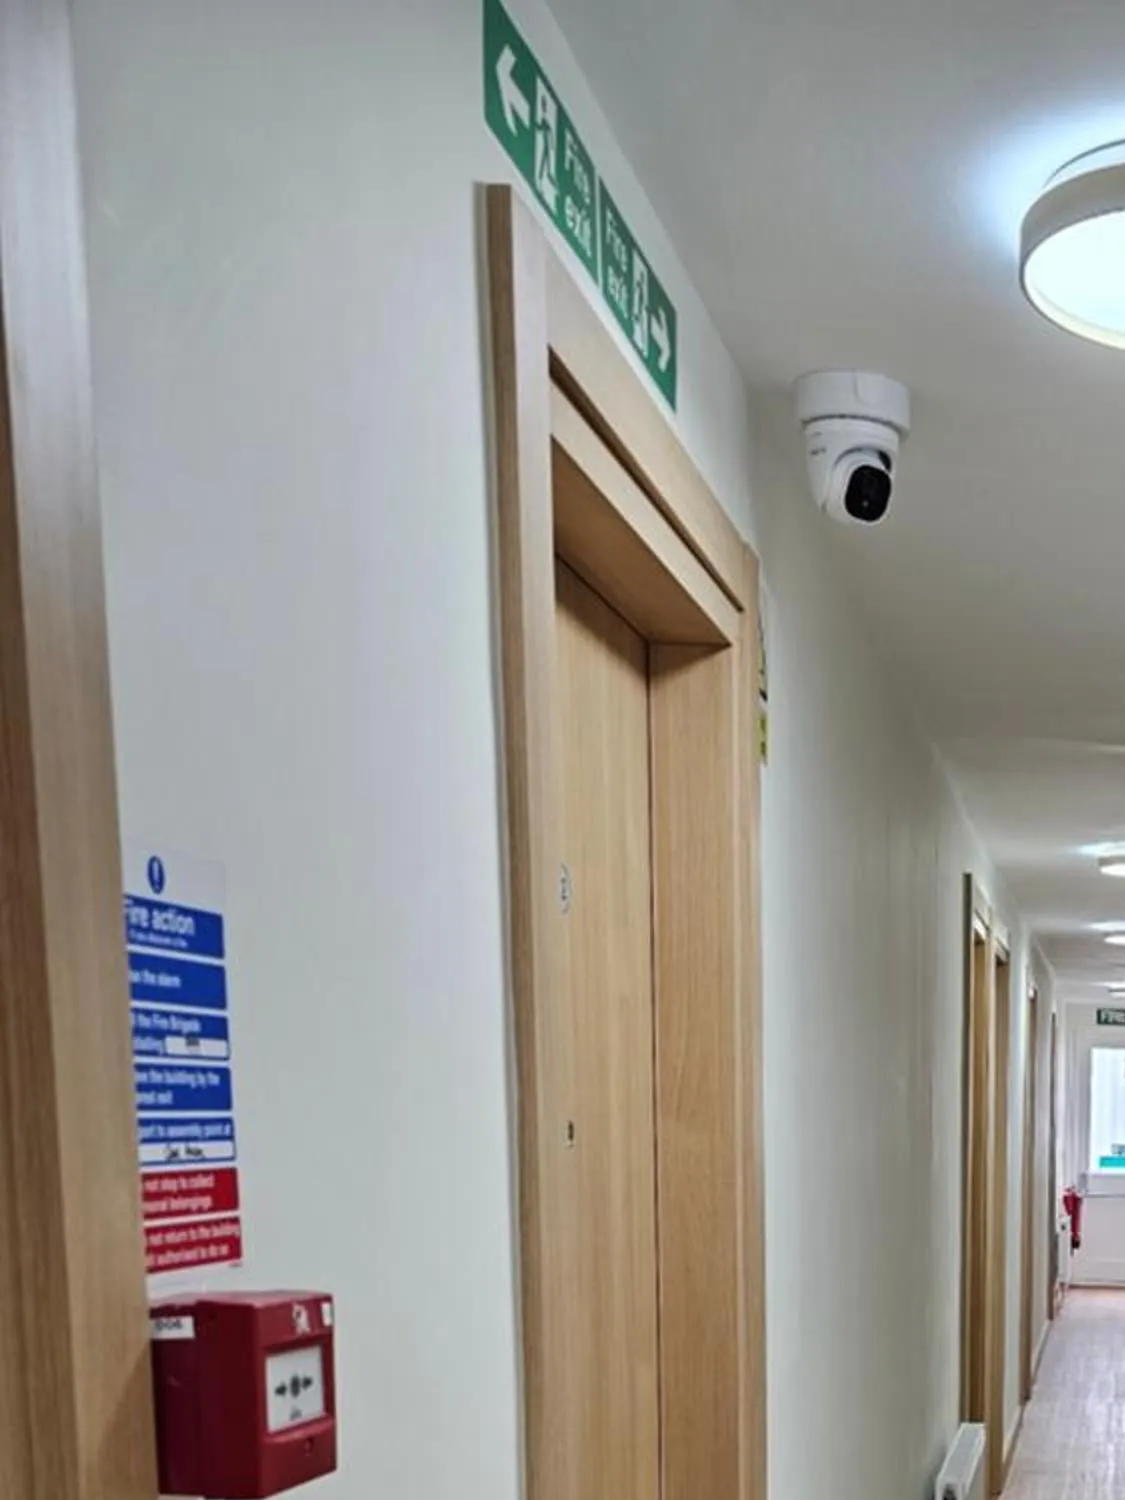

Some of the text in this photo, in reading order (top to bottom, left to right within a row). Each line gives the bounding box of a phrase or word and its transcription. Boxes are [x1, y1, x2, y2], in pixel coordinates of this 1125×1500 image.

[564, 127, 590, 205] Fire
[565, 195, 592, 258] exit
[605, 207, 628, 273] Fire
[607, 265, 629, 320] exit
[152, 908, 196, 936] action
